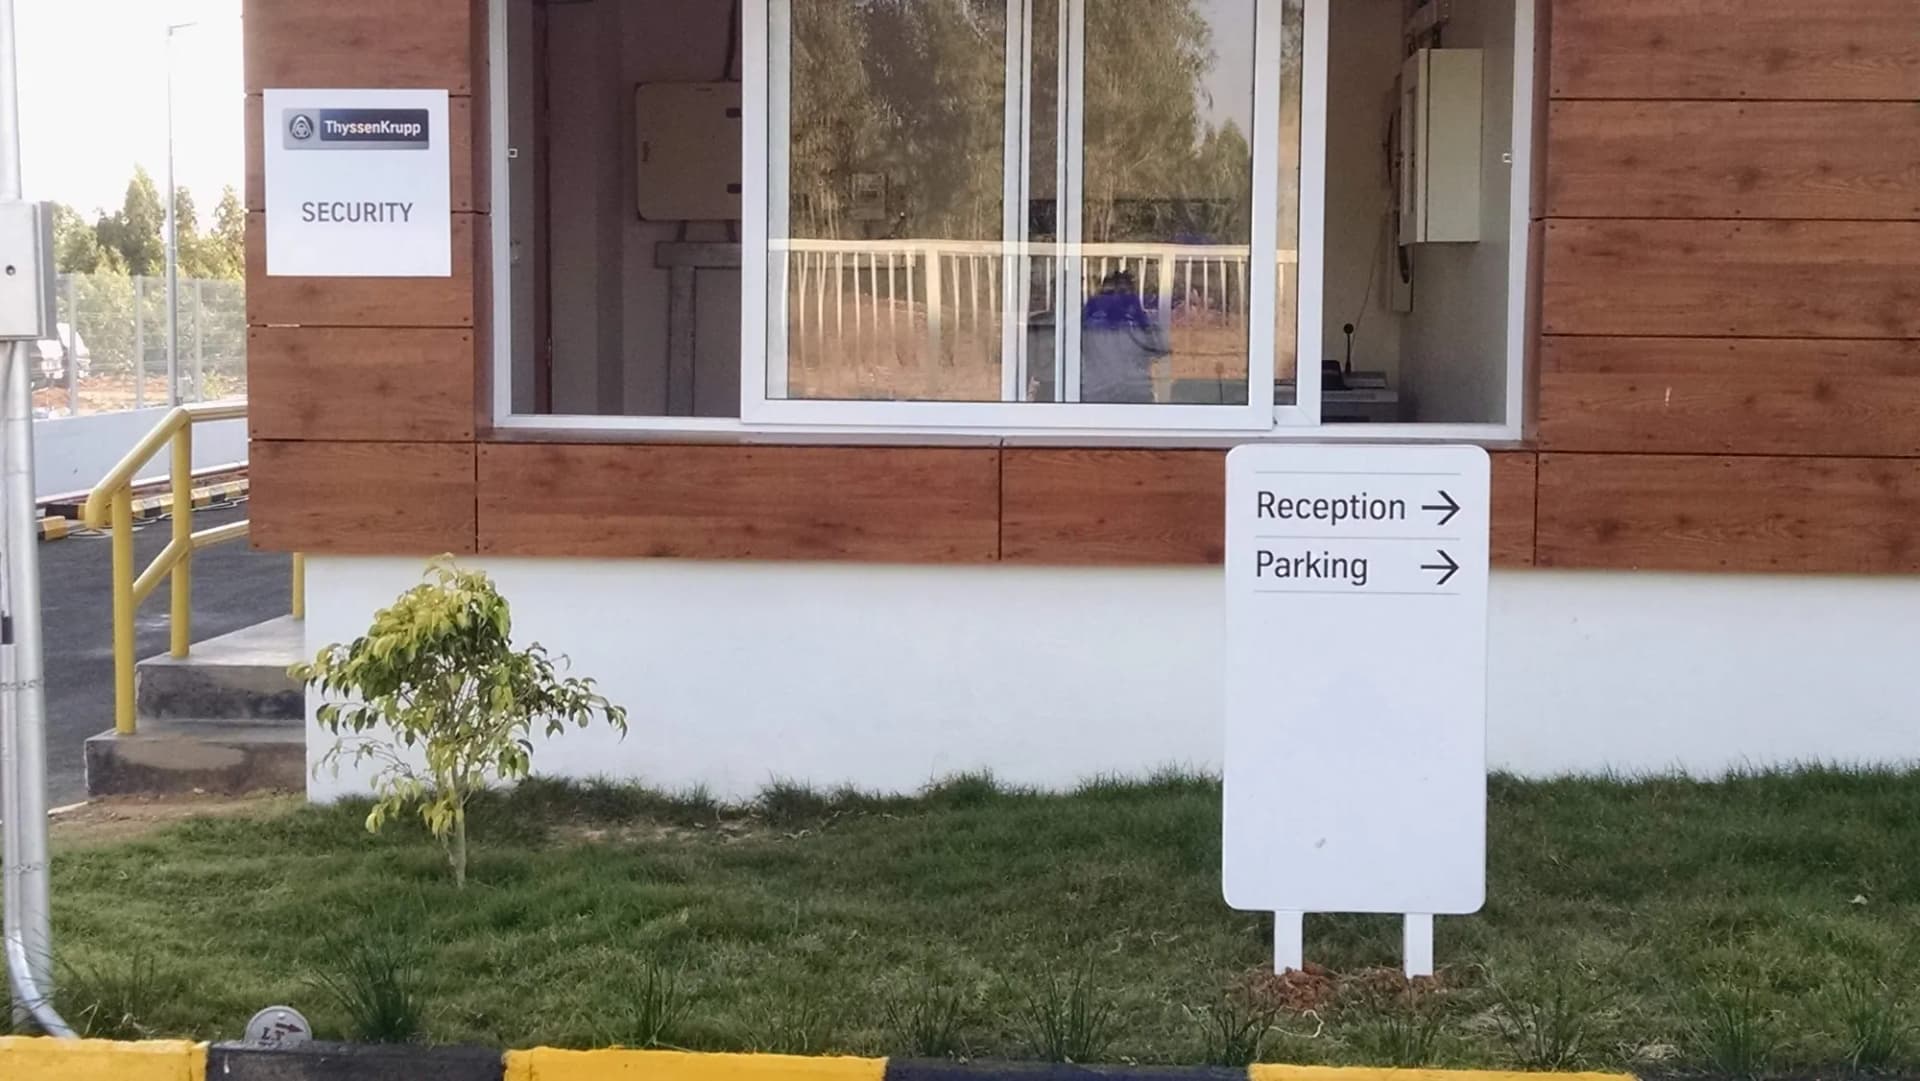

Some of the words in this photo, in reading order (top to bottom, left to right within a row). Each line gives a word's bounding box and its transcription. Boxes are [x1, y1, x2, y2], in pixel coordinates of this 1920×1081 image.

[324, 120, 421, 137] ThyssenKrupp
[302, 201, 413, 222] SECURITY
[1257, 491, 1405, 526] Reception
[1256, 550, 1367, 586] Parking
